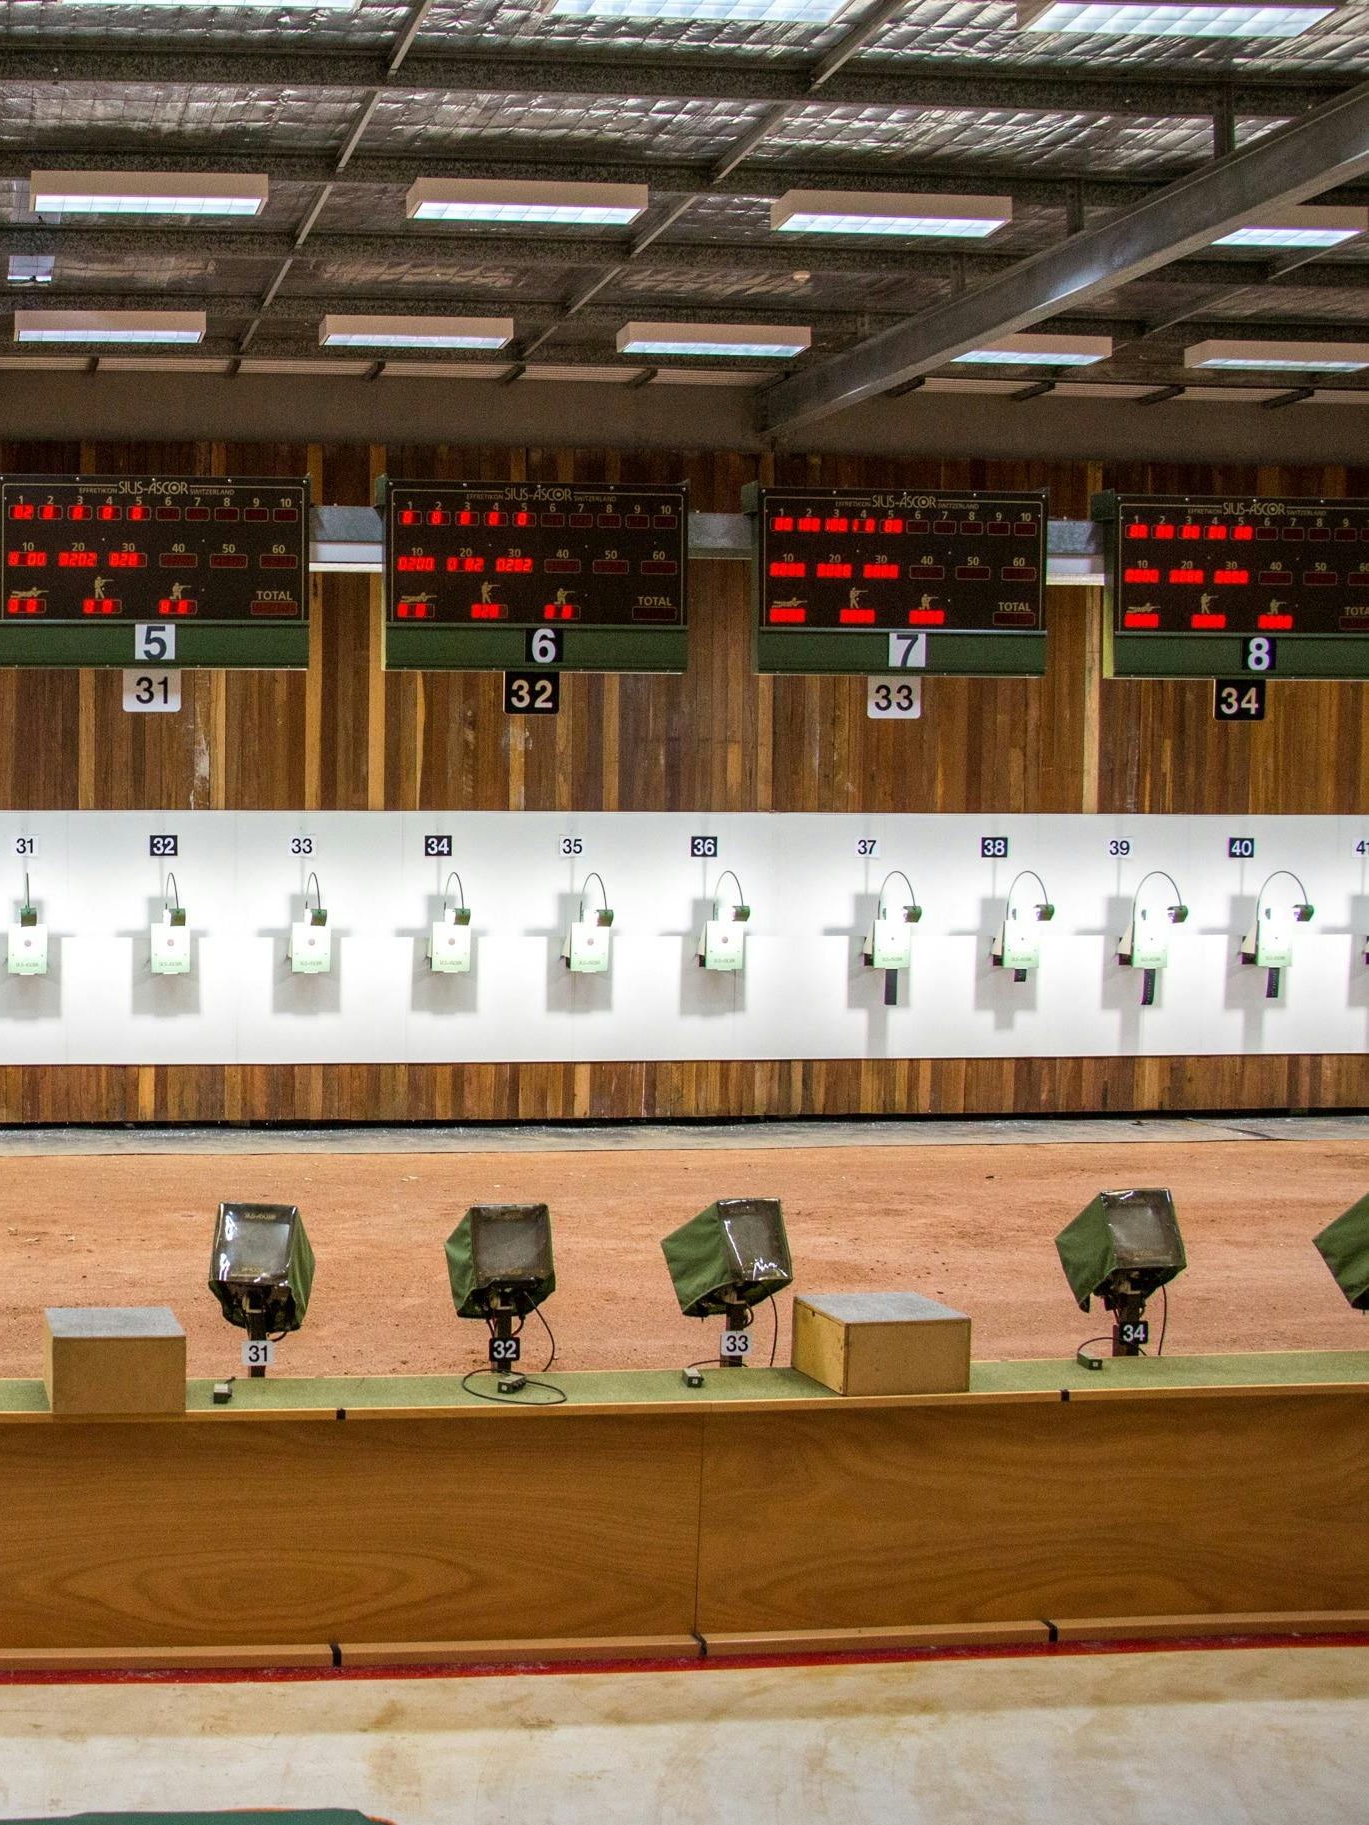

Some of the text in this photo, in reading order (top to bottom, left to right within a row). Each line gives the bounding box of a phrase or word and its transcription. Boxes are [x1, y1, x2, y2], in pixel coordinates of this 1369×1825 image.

[165, 497, 172, 507] 6
[194, 497, 201, 507] 7
[223, 498, 231, 507] 8
[253, 498, 260, 508] 9
[280, 498, 292, 508] 10
[549, 504, 556, 513] 6
[577, 504, 585, 514] 7
[606, 504, 613, 514] 8
[634, 505, 641, 515] 9
[660, 505, 672, 515] 10
[22, 542, 286, 554] 10 20 30 40 50 60
[411, 547, 666, 561] 10 20 30 40 50 60
[256, 590, 293, 601] TOTAL
[638, 596, 671, 607] TOTAL
[998, 602, 1031, 612] TOTAL
[144, 626, 167, 660] 5
[532, 629, 556, 664] 6
[896, 634, 919, 668] 7
[1247, 637, 1270, 671] 8
[136, 677, 169, 704] 31
[511, 680, 553, 709] 32
[875, 684, 913, 711] 33
[1220, 687, 1258, 714] 34
[17, 839, 33, 853] 31
[153, 838, 174, 854] 32
[292, 839, 312, 853] 33
[428, 838, 449, 854] 34
[563, 839, 582, 854] 35
[694, 839, 714, 855] 36
[858, 840, 876, 854] 37
[984, 840, 1004, 855] 38
[1110, 841, 1129, 855] 39
[1232, 841, 1251, 855] 40
[1123, 1325, 1144, 1341] 34
[494, 1341, 516, 1358] 32
[727, 1335, 748, 1352] 33
[249, 1345, 267, 1362] 31
